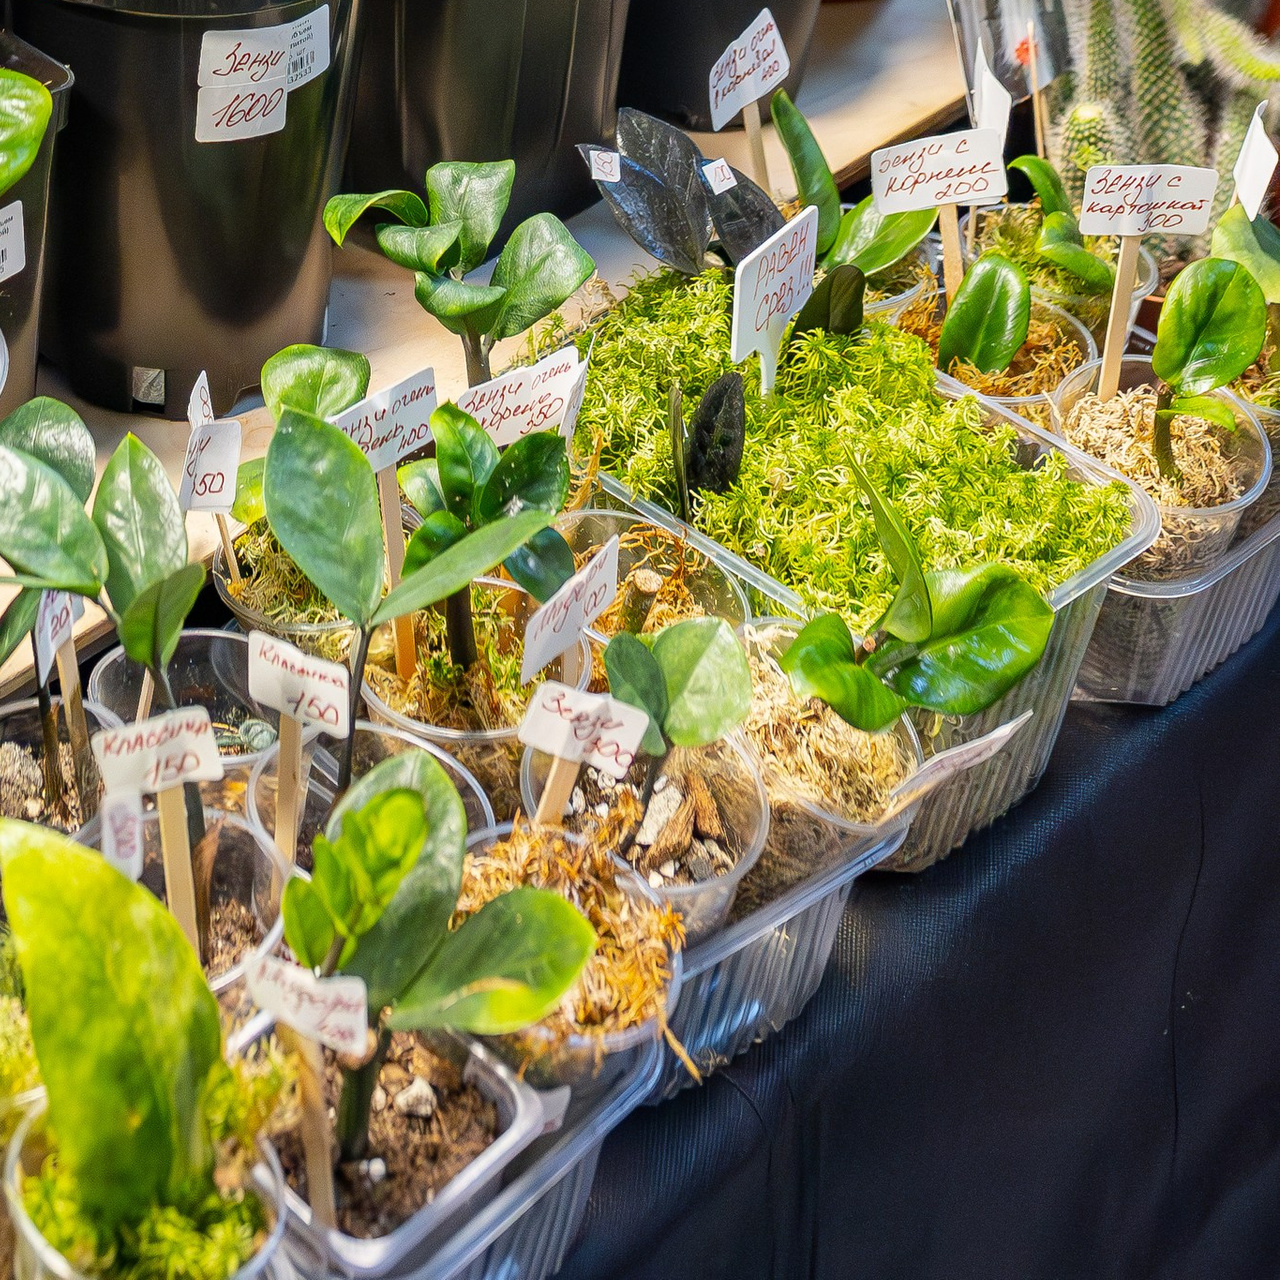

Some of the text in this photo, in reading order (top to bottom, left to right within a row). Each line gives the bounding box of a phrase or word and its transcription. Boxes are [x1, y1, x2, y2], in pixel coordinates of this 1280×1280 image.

[212, 42, 286, 83] Зензи
[212, 87, 285, 128] 1600
[879, 142, 944, 174] Зензи
[934, 176, 990, 201] 200
[1090, 168, 1163, 207] Зензи
[1085, 199, 1210, 221] картошкой
[1137, 211, 1184, 233] 300
[464, 381, 524, 417] Зензи
[144, 750, 201, 786] 150
